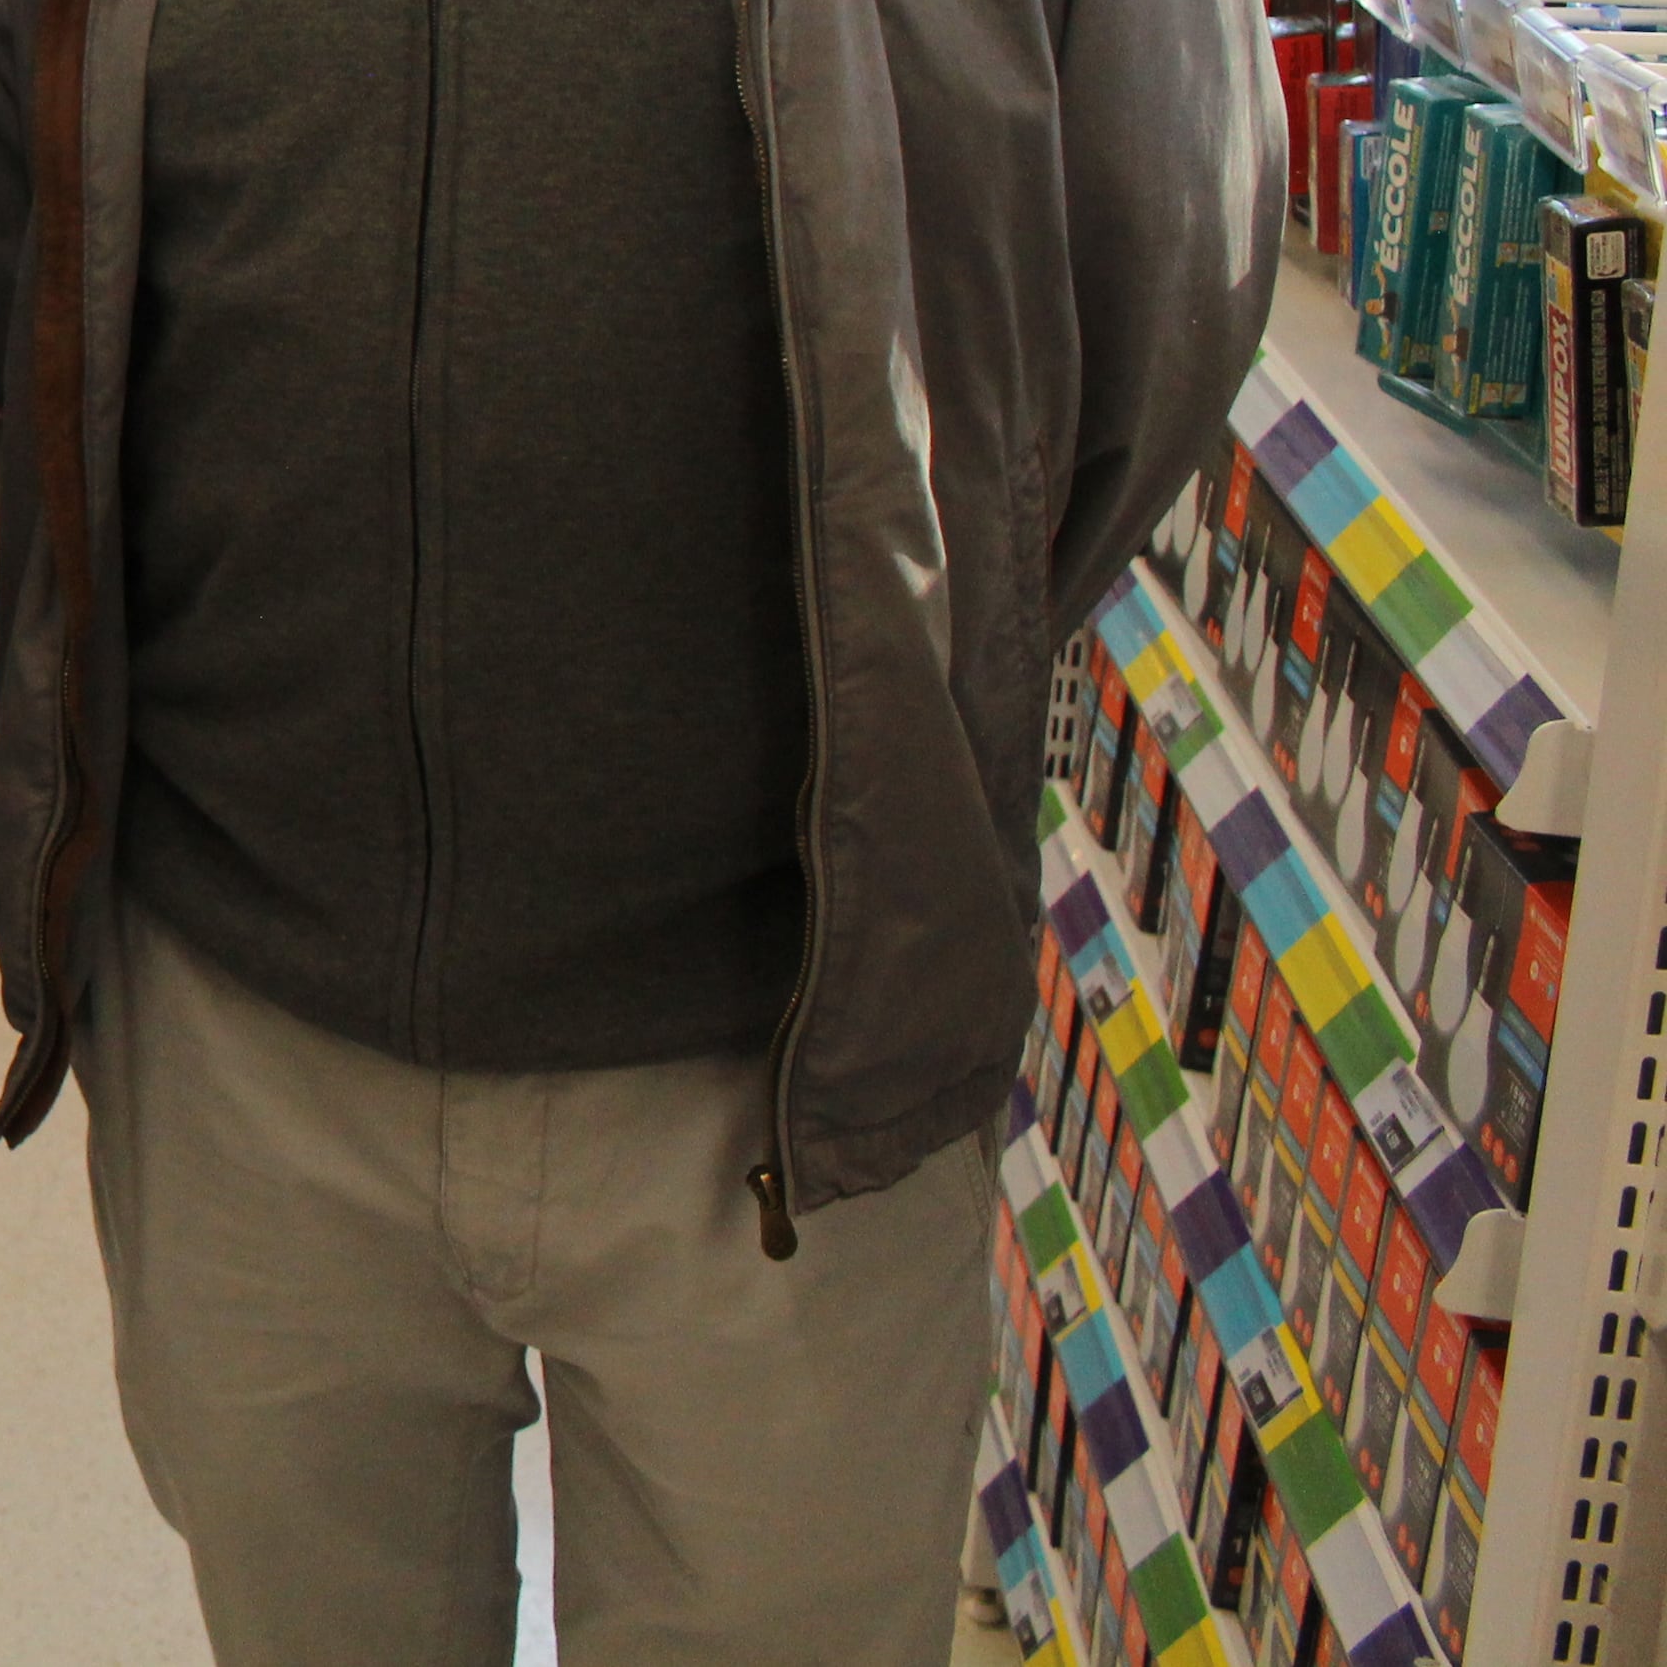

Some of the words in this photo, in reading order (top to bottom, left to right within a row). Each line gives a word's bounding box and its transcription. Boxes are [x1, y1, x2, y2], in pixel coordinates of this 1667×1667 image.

[1374, 98, 1415, 273] ÉCCOLE
[1449, 123, 1484, 307] ÉCCOLE
[1553, 313, 1573, 484] UNIPOX
